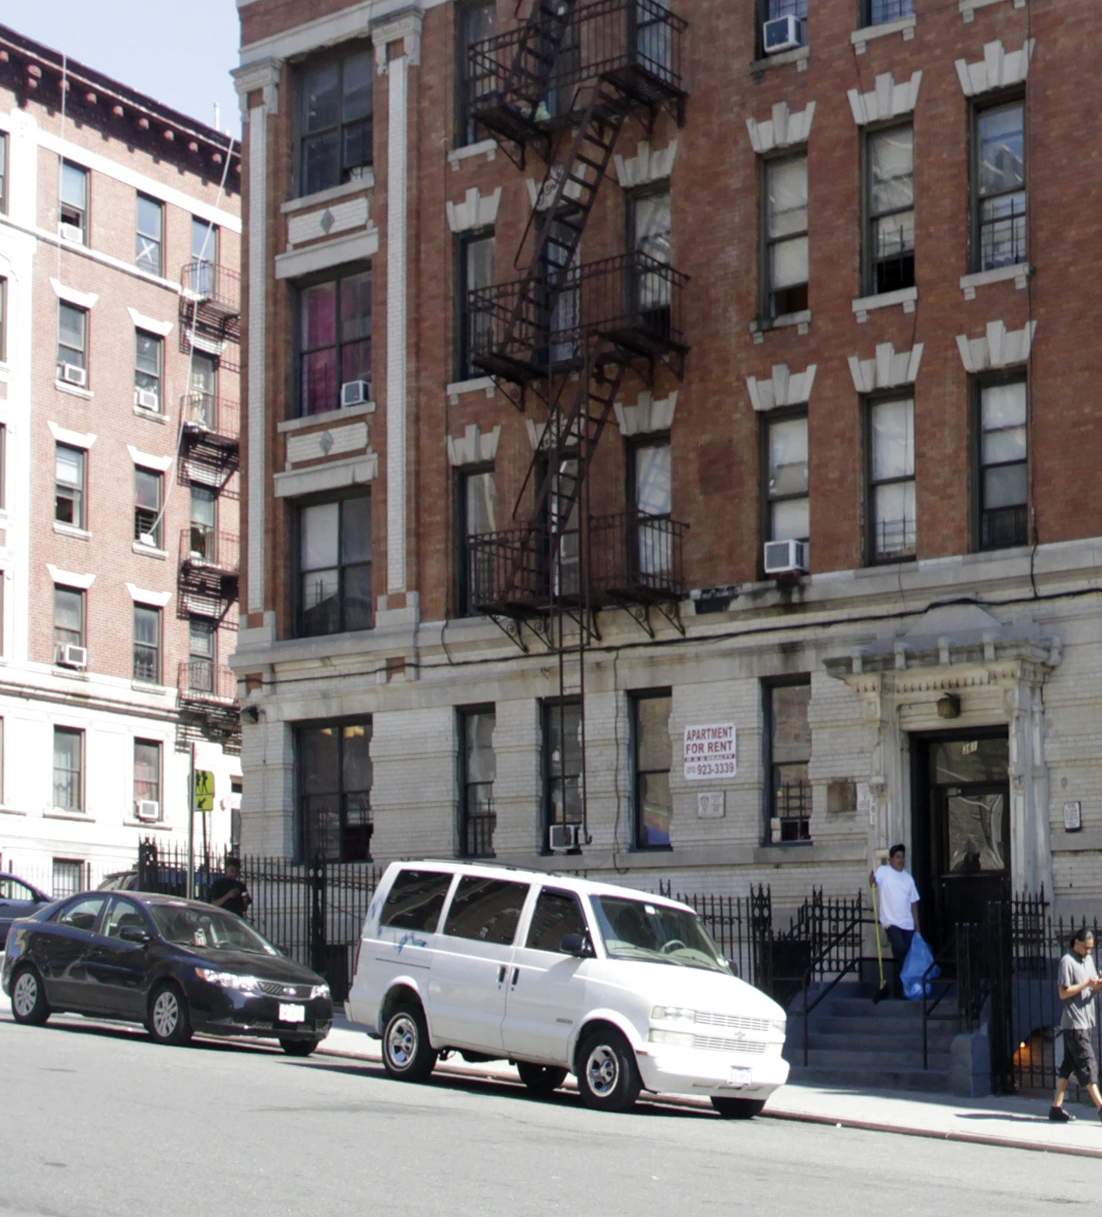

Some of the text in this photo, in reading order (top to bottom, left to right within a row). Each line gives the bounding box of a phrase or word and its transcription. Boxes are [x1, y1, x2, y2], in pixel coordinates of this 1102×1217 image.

[686, 726, 733, 741] APARTMENT
[686, 741, 733, 755] FOR RENT
[697, 762, 734, 775] 923-3339
